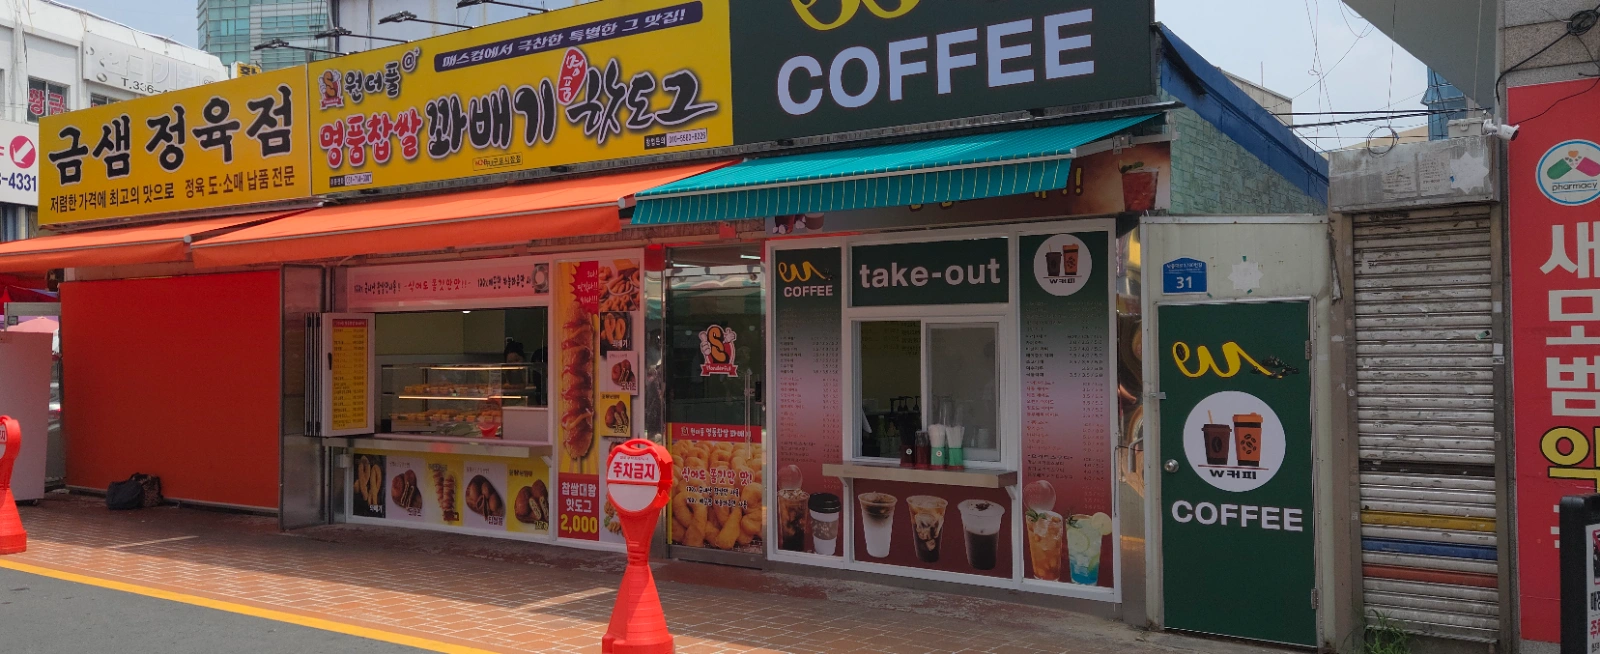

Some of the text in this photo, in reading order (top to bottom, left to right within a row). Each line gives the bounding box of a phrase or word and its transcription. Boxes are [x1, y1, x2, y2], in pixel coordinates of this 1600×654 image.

[442, 8, 686, 68] 매스컴에서 극찬한 특별한 그 맛집!
[776, 8, 1095, 116] COFFEE
[343, 60, 400, 103] 원더풀
[319, 107, 423, 169] 명품찹쌀
[425, 77, 557, 158] 꽈배기
[566, 58, 718, 145] 핫도그
[48, 84, 294, 186] 금샘 정육점
[0, 172, 37, 192] -4331
[50, 194, 77, 214] 저렴한
[79, 190, 107, 211] 가격에
[109, 186, 139, 208] 최고의
[143, 182, 175, 204] 맛으로
[185, 177, 206, 198] 정육
[247, 169, 270, 190] 납품
[272, 165, 295, 187] 전문
[1552, 180, 1598, 191] pharmacy
[859, 258, 1001, 289] take-out
[1176, 276, 1192, 289] 31
[784, 285, 833, 298] COFFEE
[613, 461, 656, 480] 주차금지
[562, 482, 597, 498] 찹쌀대왕
[566, 498, 592, 513] 핫도그
[1172, 500, 1303, 532] COFFEE
[560, 514, 598, 533] 2,000
